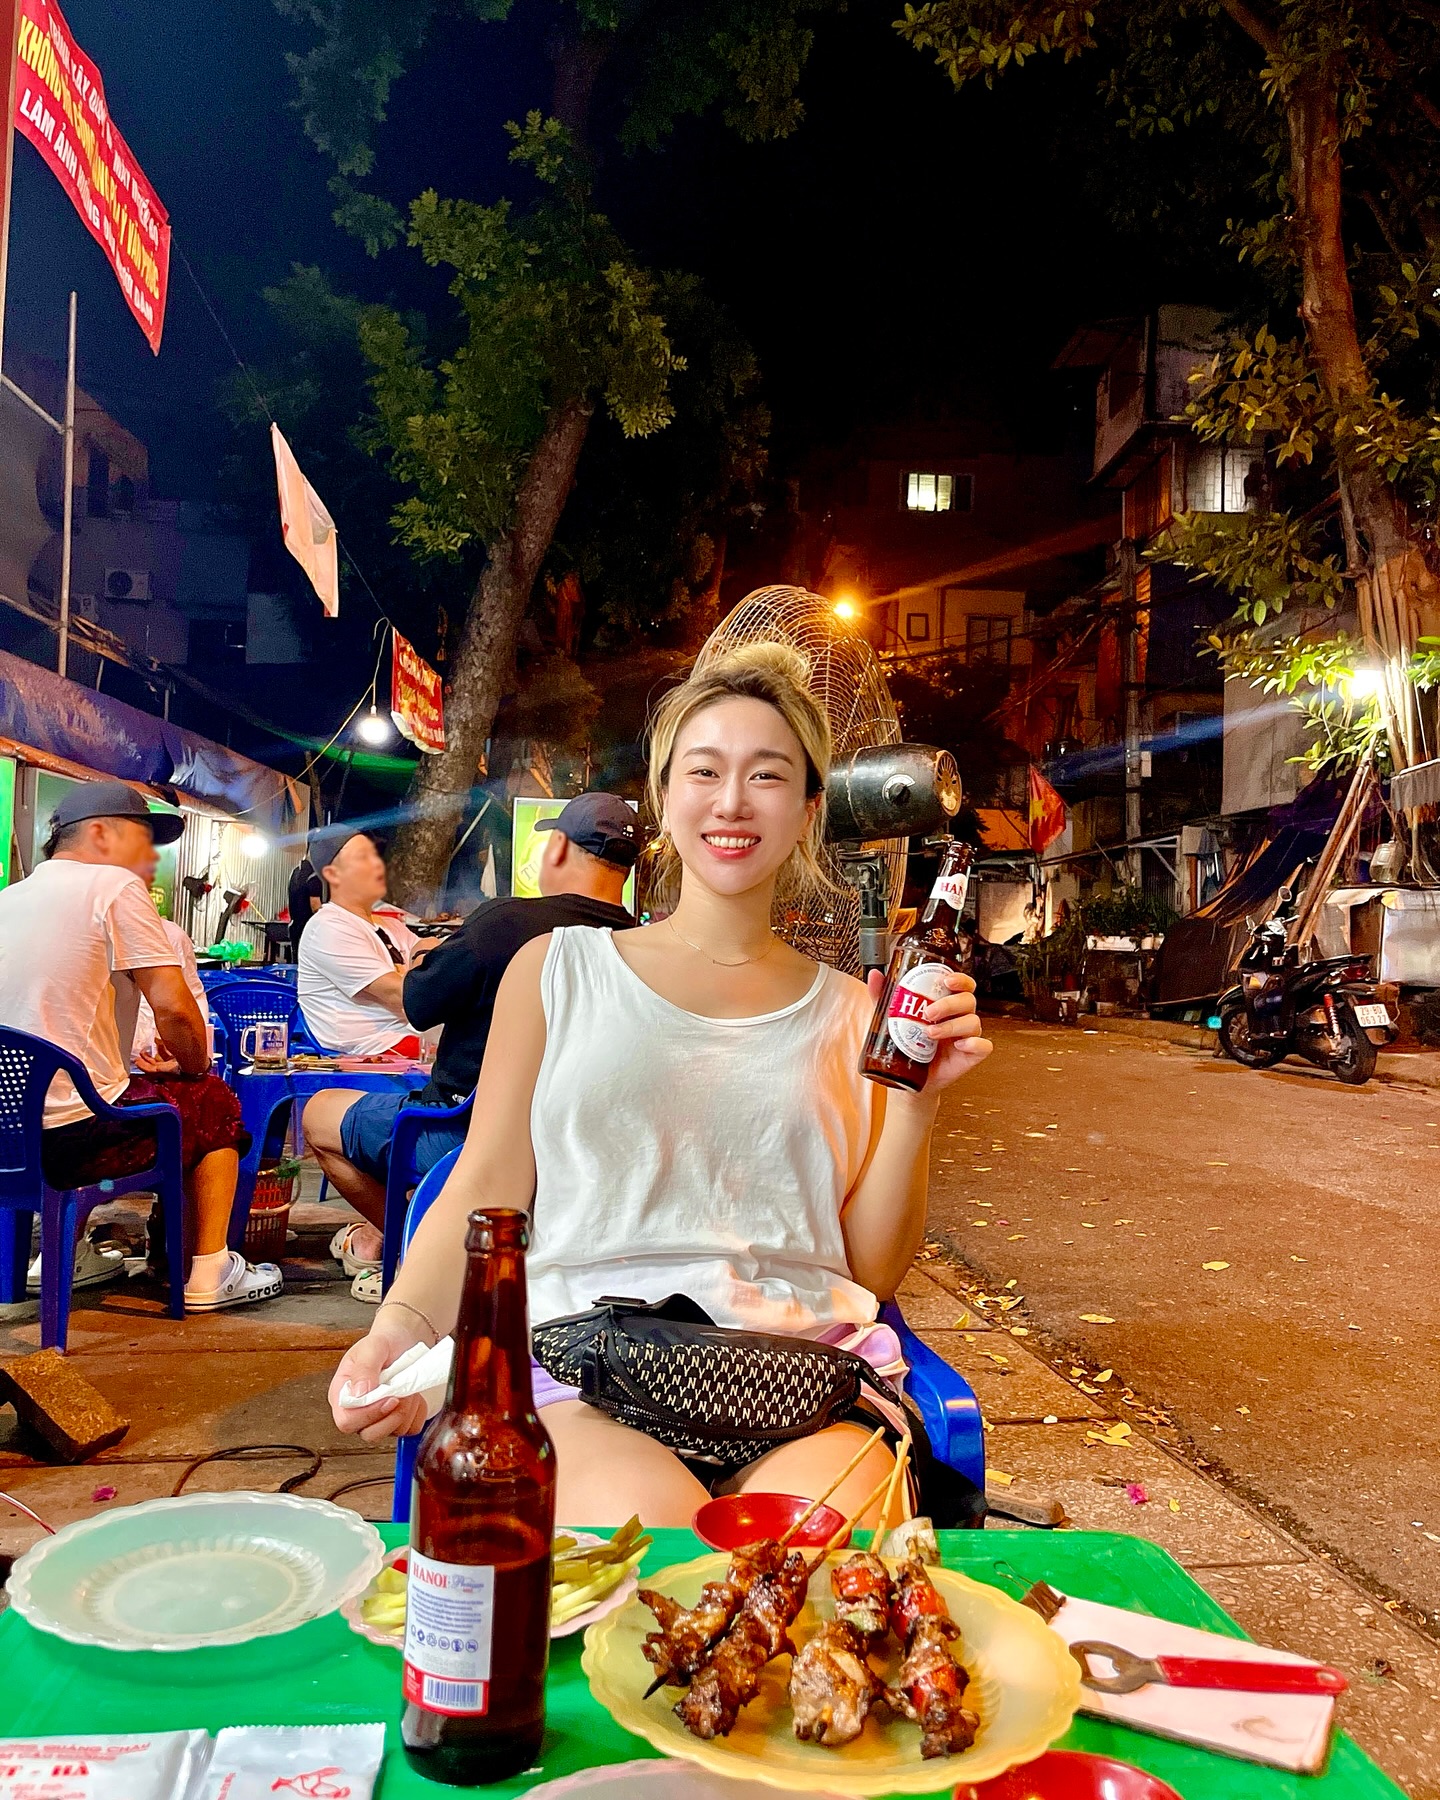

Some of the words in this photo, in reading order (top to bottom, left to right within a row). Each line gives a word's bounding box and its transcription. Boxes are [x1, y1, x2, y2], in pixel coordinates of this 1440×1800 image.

[17, 14, 62, 102] KHÔNG
[19, 88, 56, 143] LÀM
[53, 121, 78, 180] ẢNH
[247, 1280, 282, 1300] crocs
[413, 1562, 448, 1588] HANOI
